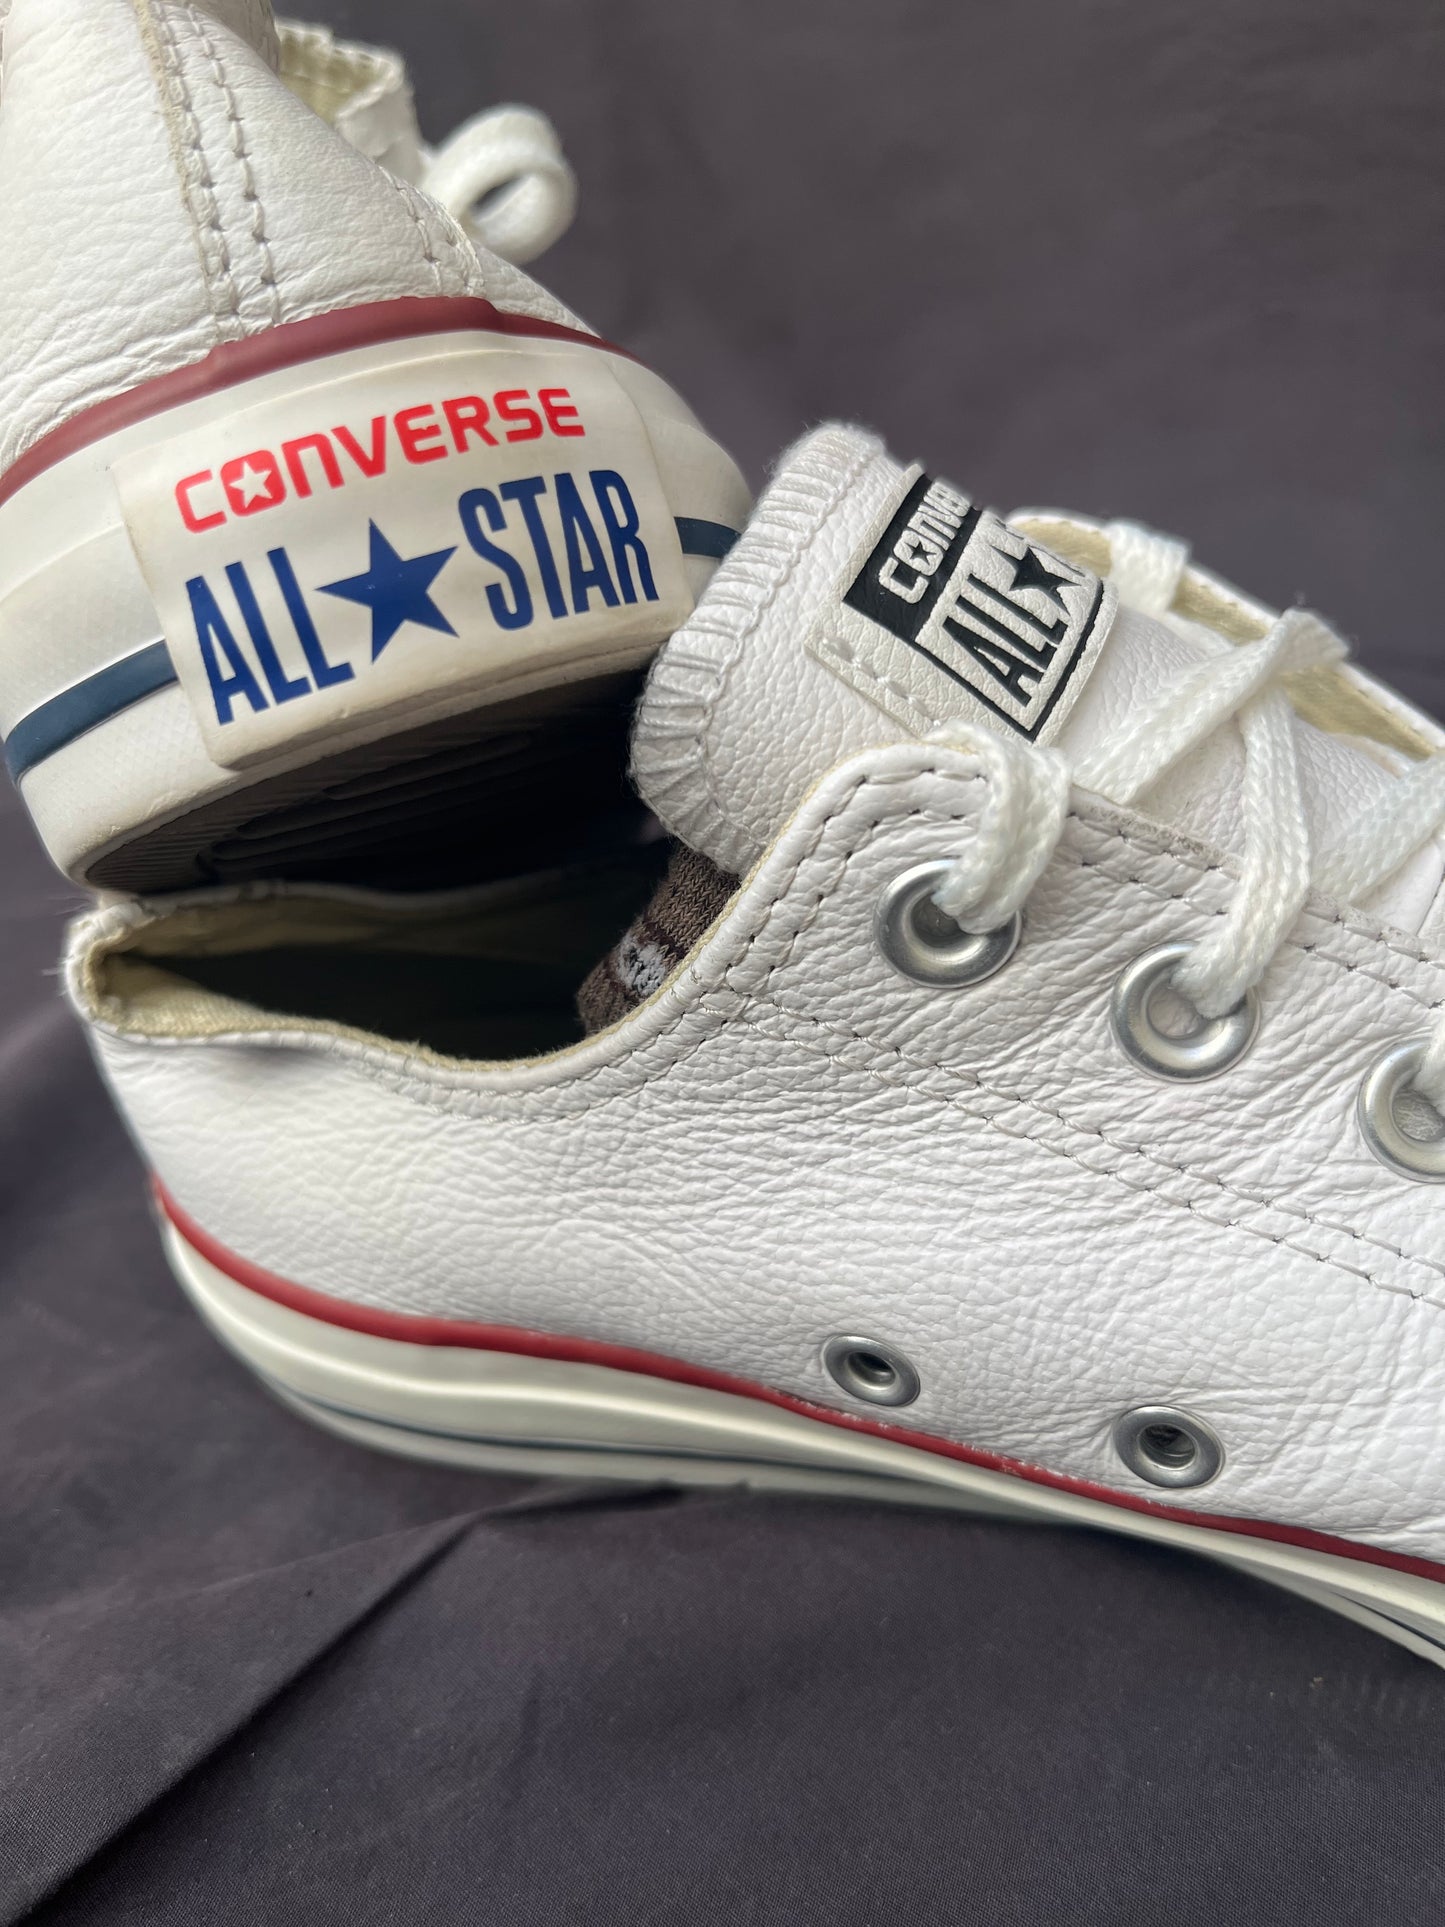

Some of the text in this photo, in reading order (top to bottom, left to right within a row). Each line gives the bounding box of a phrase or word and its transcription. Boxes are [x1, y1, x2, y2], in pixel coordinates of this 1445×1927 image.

[175, 388, 586, 534] CONVERSE
[185, 470, 659, 726] ALL STAR
[942, 573, 1069, 708] ALL
